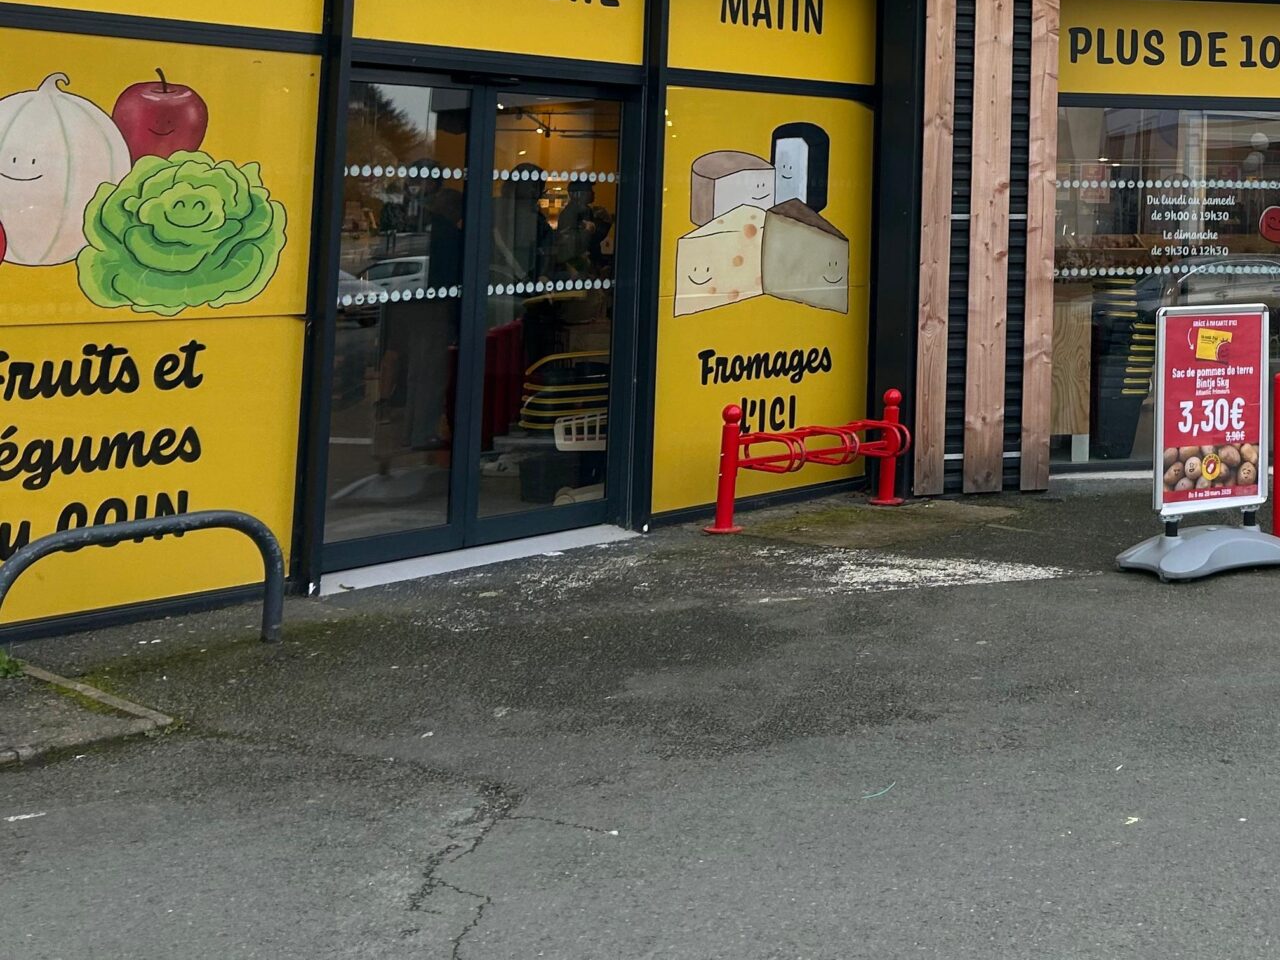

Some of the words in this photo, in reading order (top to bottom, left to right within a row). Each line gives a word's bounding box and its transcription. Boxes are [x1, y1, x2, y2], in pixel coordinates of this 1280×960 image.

[1068, 27, 1165, 67] PLUS
[1179, 30, 1228, 68] DE
[1147, 195, 1159, 205] Du
[1161, 194, 1187, 205] lundi
[1188, 197, 1200, 205] au
[1202, 195, 1235, 205] samedi
[1151, 210, 1162, 220] de
[1164, 211, 1190, 221] 9h00
[1191, 210, 1198, 220] à
[1200, 211, 1229, 221] 19h30
[1163, 230, 1172, 240] Le
[1174, 229, 1218, 240] dimanche
[1151, 245, 1162, 256] de
[1164, 246, 1189, 256] 9h30
[1191, 245, 1197, 256] à
[1200, 246, 1229, 256] 12h30
[154, 340, 206, 390] et
[698, 347, 832, 385] Fromages
[1172, 368, 1185, 378] Sac
[1186, 367, 1195, 377] de
[1197, 367, 1225, 378] pommes
[1227, 366, 1236, 376] de
[1237, 366, 1253, 374] terre
[1196, 378, 1215, 389] Bintje
[1216, 377, 1230, 388] 5kg
[1178, 397, 1245, 437] 3,30€
